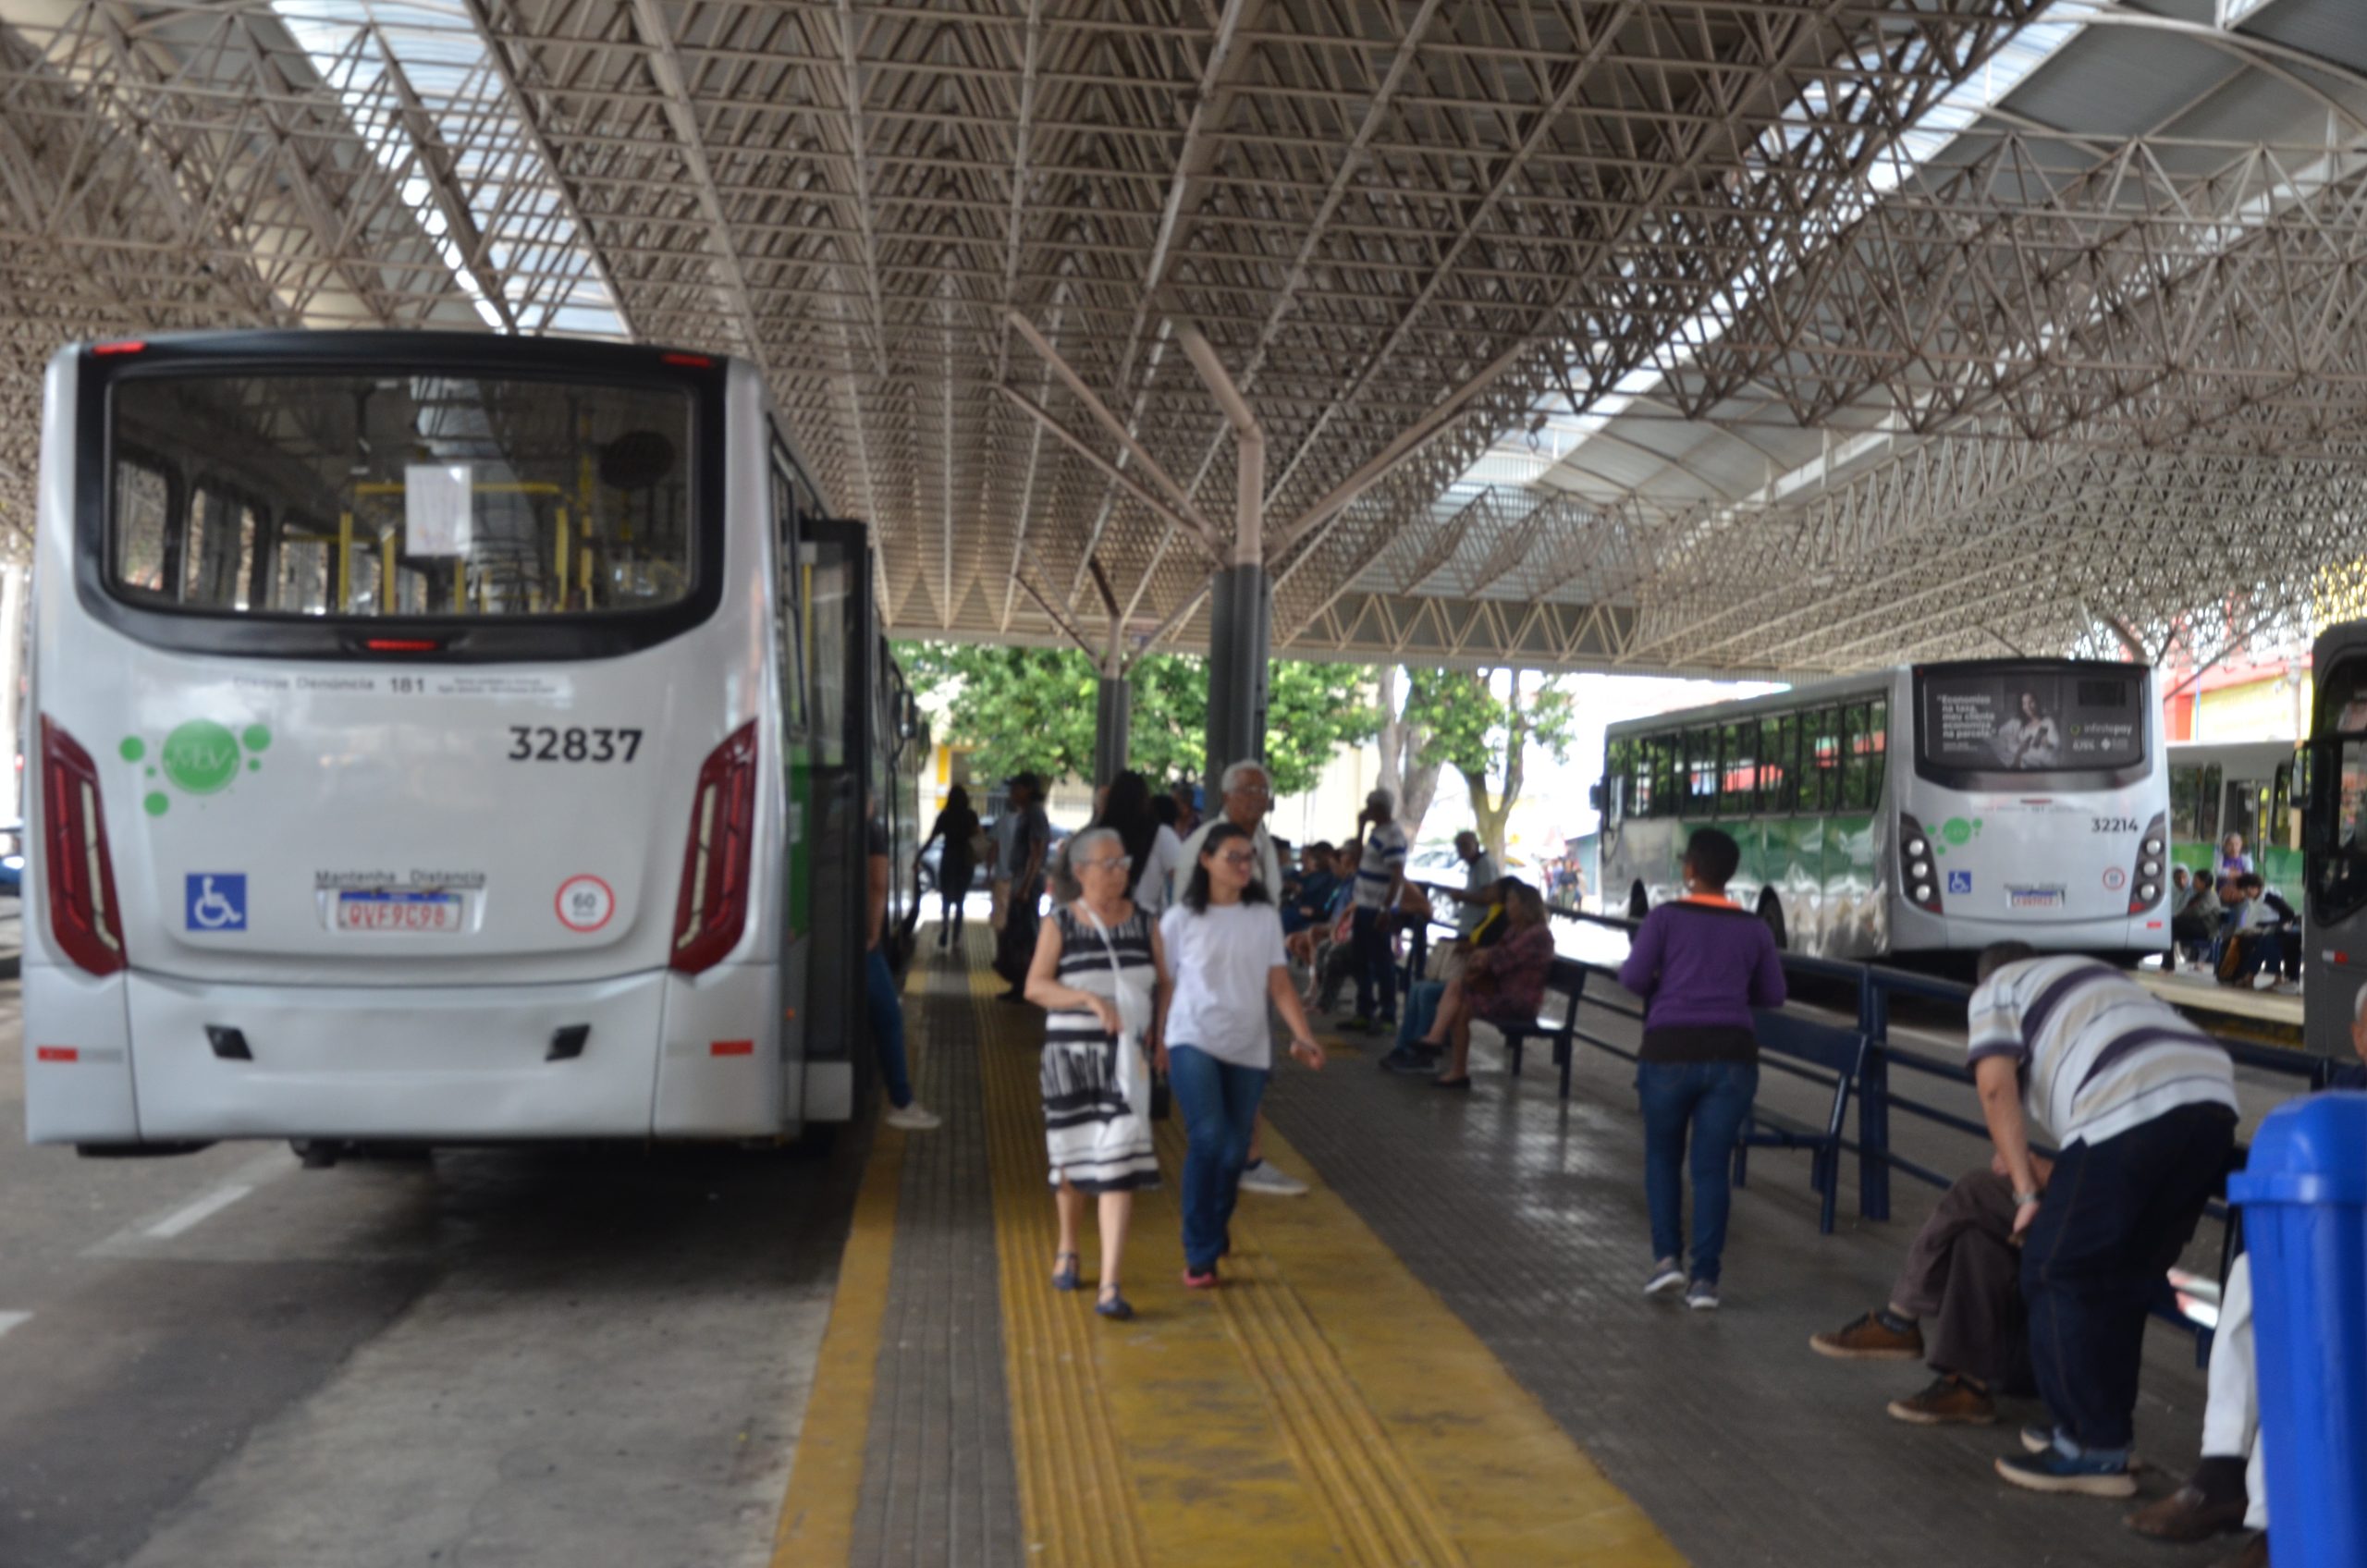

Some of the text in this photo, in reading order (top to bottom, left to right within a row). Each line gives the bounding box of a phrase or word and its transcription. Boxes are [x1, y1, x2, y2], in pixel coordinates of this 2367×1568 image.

[391, 675, 425, 693] 181
[508, 726, 644, 763] 32837
[2091, 817, 2138, 833] 32214
[572, 892, 596, 909] 60
